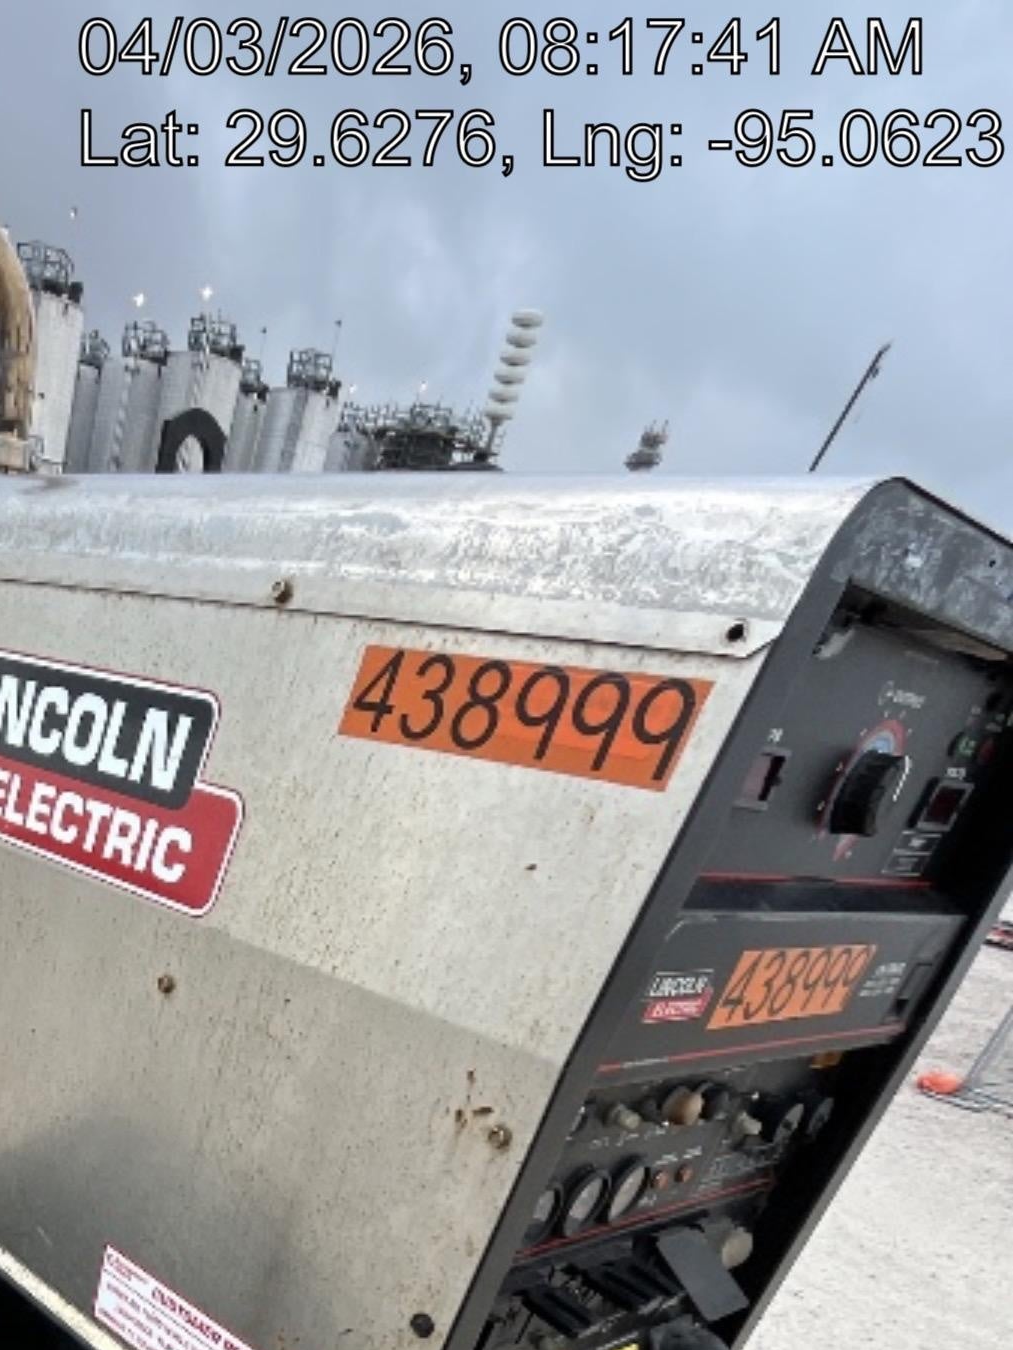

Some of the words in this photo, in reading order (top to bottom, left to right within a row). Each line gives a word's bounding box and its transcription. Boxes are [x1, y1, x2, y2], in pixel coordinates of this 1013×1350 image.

[352, 650, 696, 781] 438999
[718, 948, 870, 1022] 438999
[151, 1286, 222, 1345] CUSTOMER
